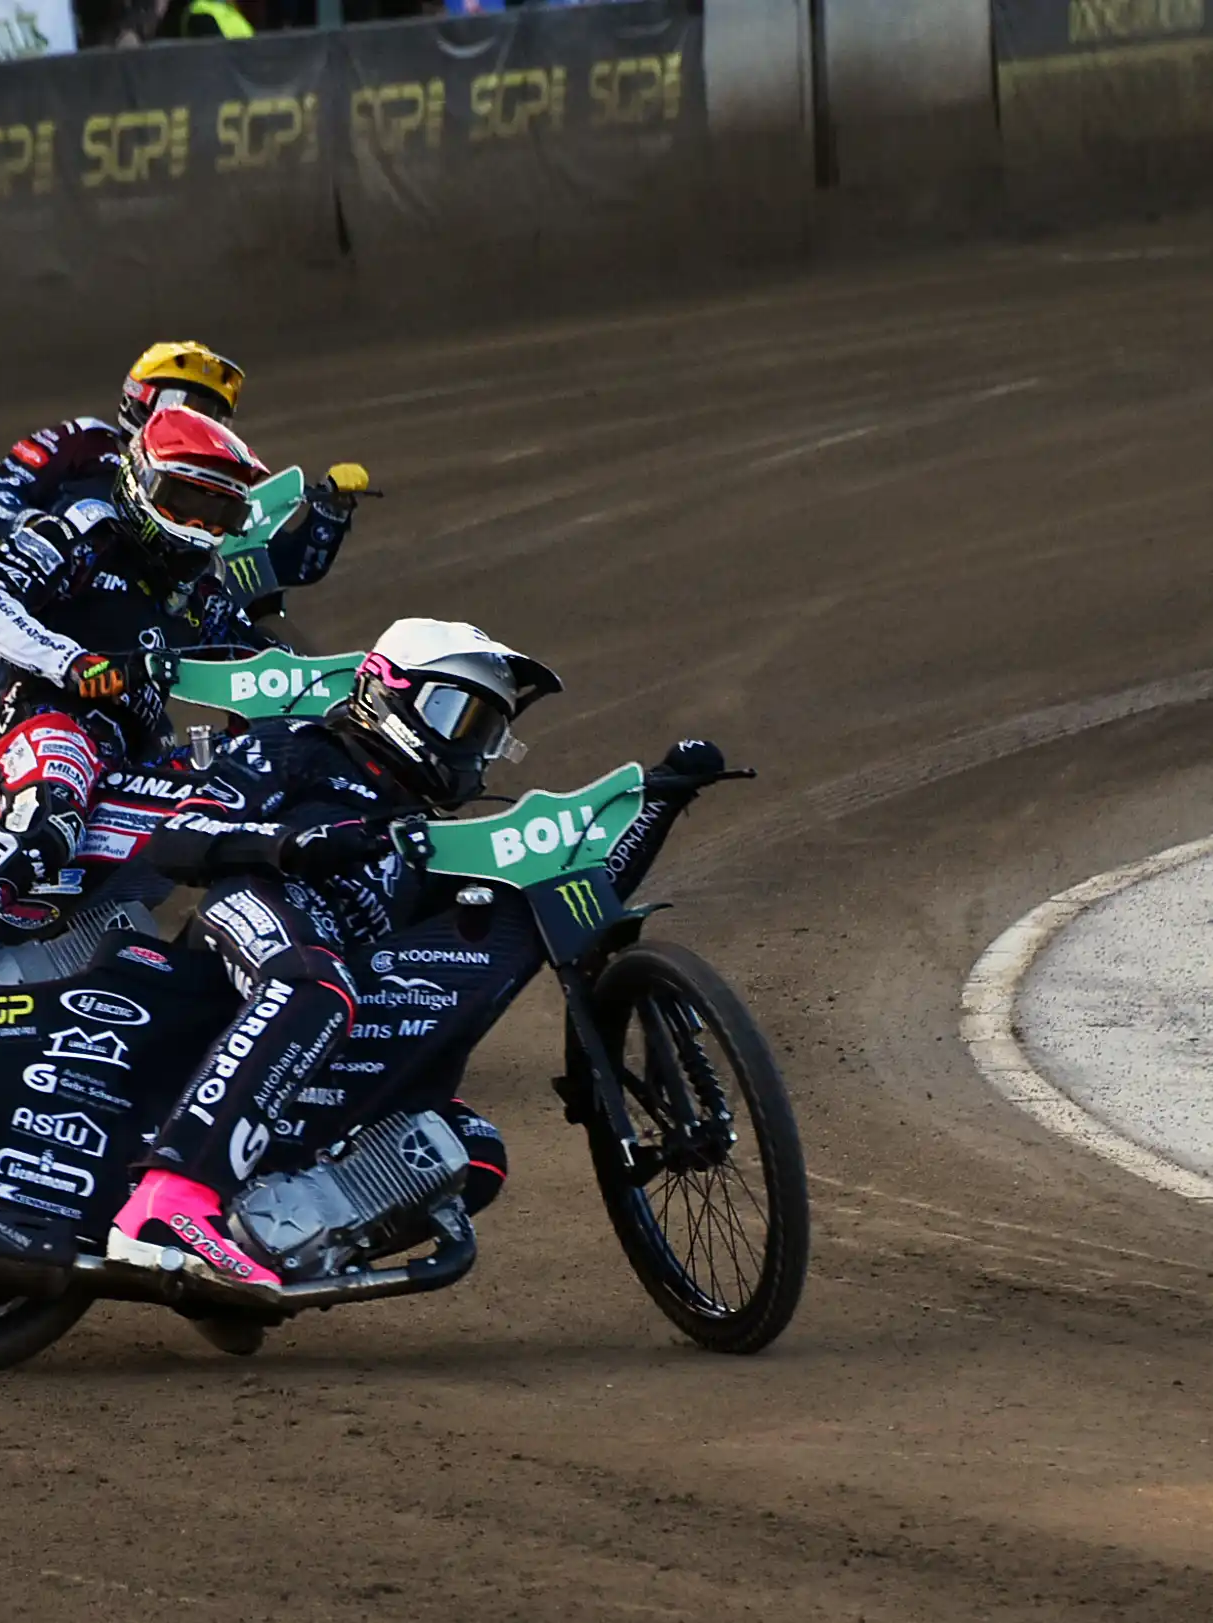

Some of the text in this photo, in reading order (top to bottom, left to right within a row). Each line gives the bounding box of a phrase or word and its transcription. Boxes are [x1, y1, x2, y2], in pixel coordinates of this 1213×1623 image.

[231, 668, 331, 701] BOLL
[123, 775, 193, 800] ANLA
[490, 805, 607, 868] BOLL
[398, 950, 490, 965] KOOPMANN
[292, 1011, 344, 1079] Schwarte
[349, 1019, 438, 1039] ans MF
[253, 1041, 303, 1110] Autohaus
[11, 1107, 89, 1146] ASW
[169, 1213, 255, 1278] daytona
